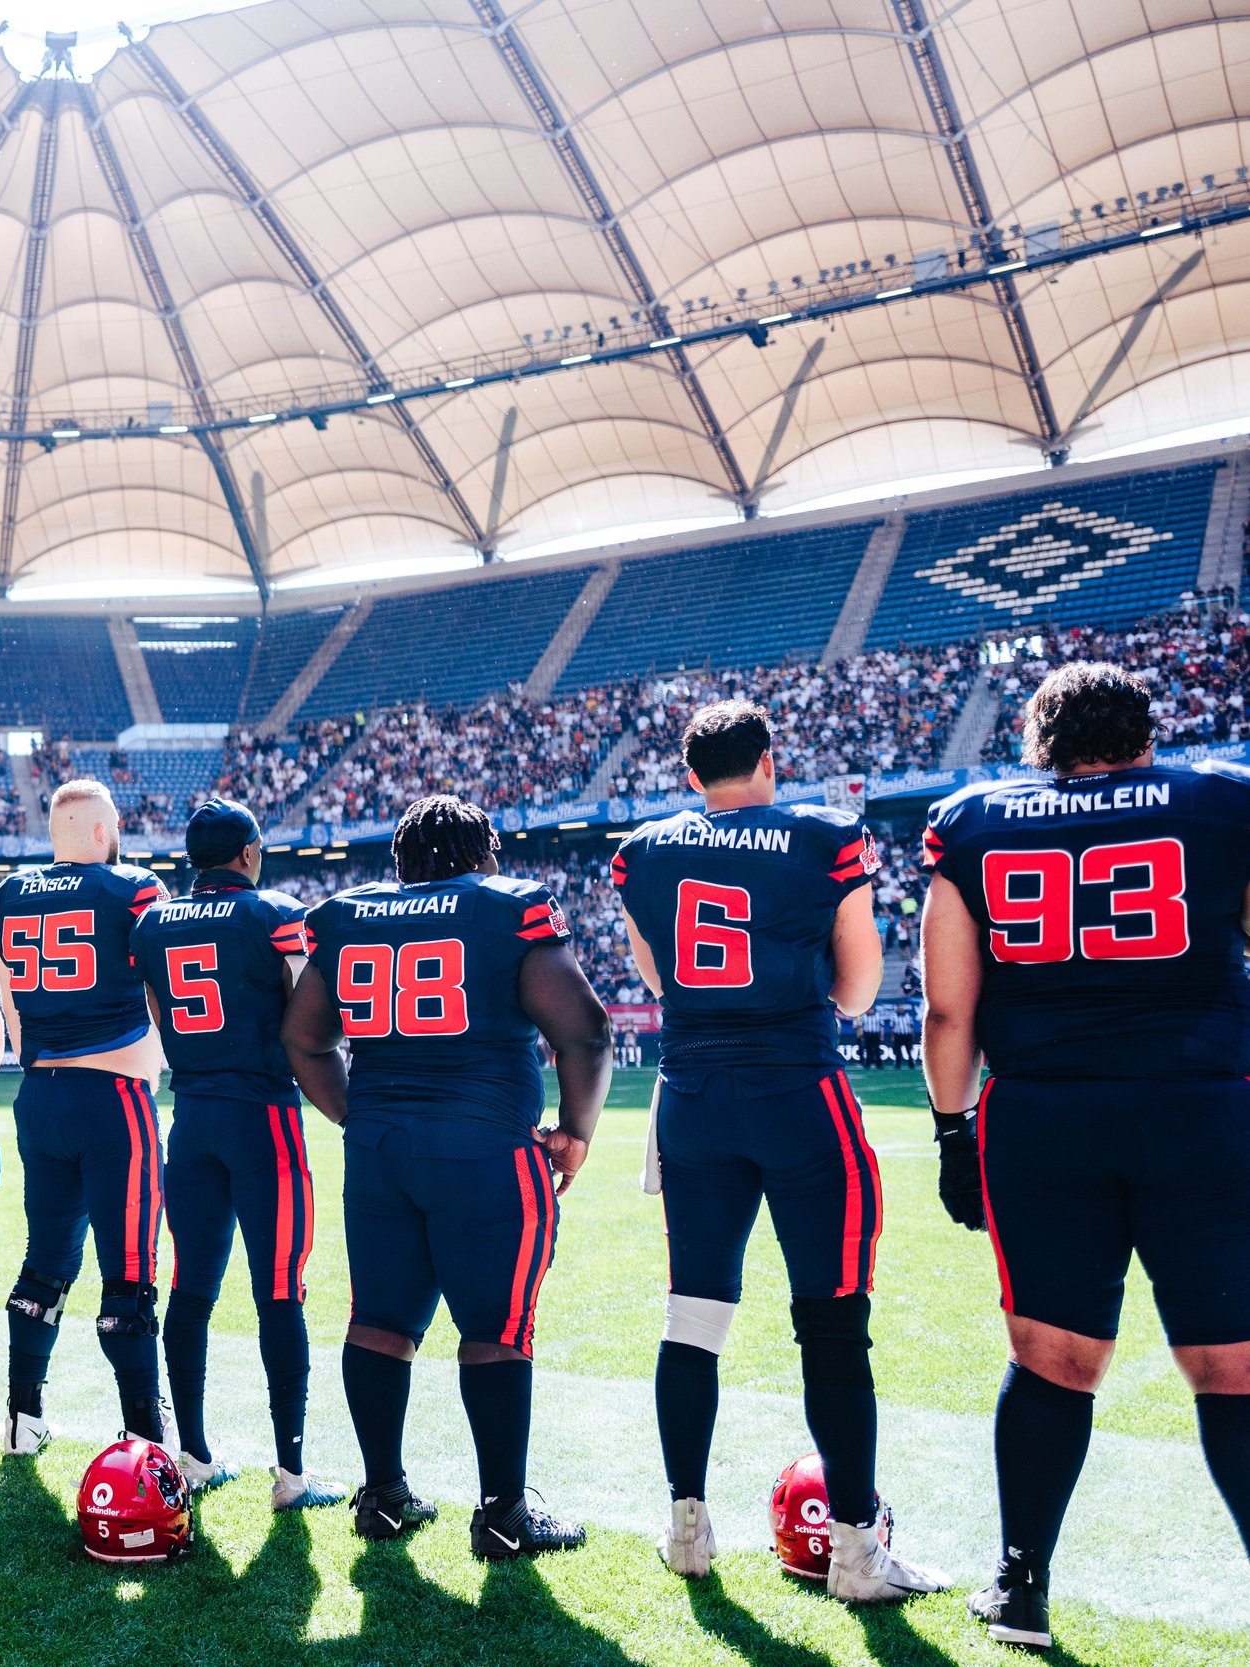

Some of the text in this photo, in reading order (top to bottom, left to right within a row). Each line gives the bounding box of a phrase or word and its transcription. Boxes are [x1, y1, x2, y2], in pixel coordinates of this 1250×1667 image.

[1004, 783, 1169, 819] KÖHNLEIN
[656, 825, 790, 853] LACHMANN
[20, 876, 83, 895] FENSCH
[355, 895, 458, 918] R.AWUAH
[982, 838, 1190, 964] 93
[674, 878, 754, 988] 6
[2, 909, 96, 992] 55
[165, 943, 225, 1034] 5
[337, 938, 469, 1038] 98
[86, 1506, 120, 1517] Schindler
[98, 1520, 110, 1538] 5
[794, 1525, 830, 1535] Schindle
[808, 1536, 823, 1555] 6
